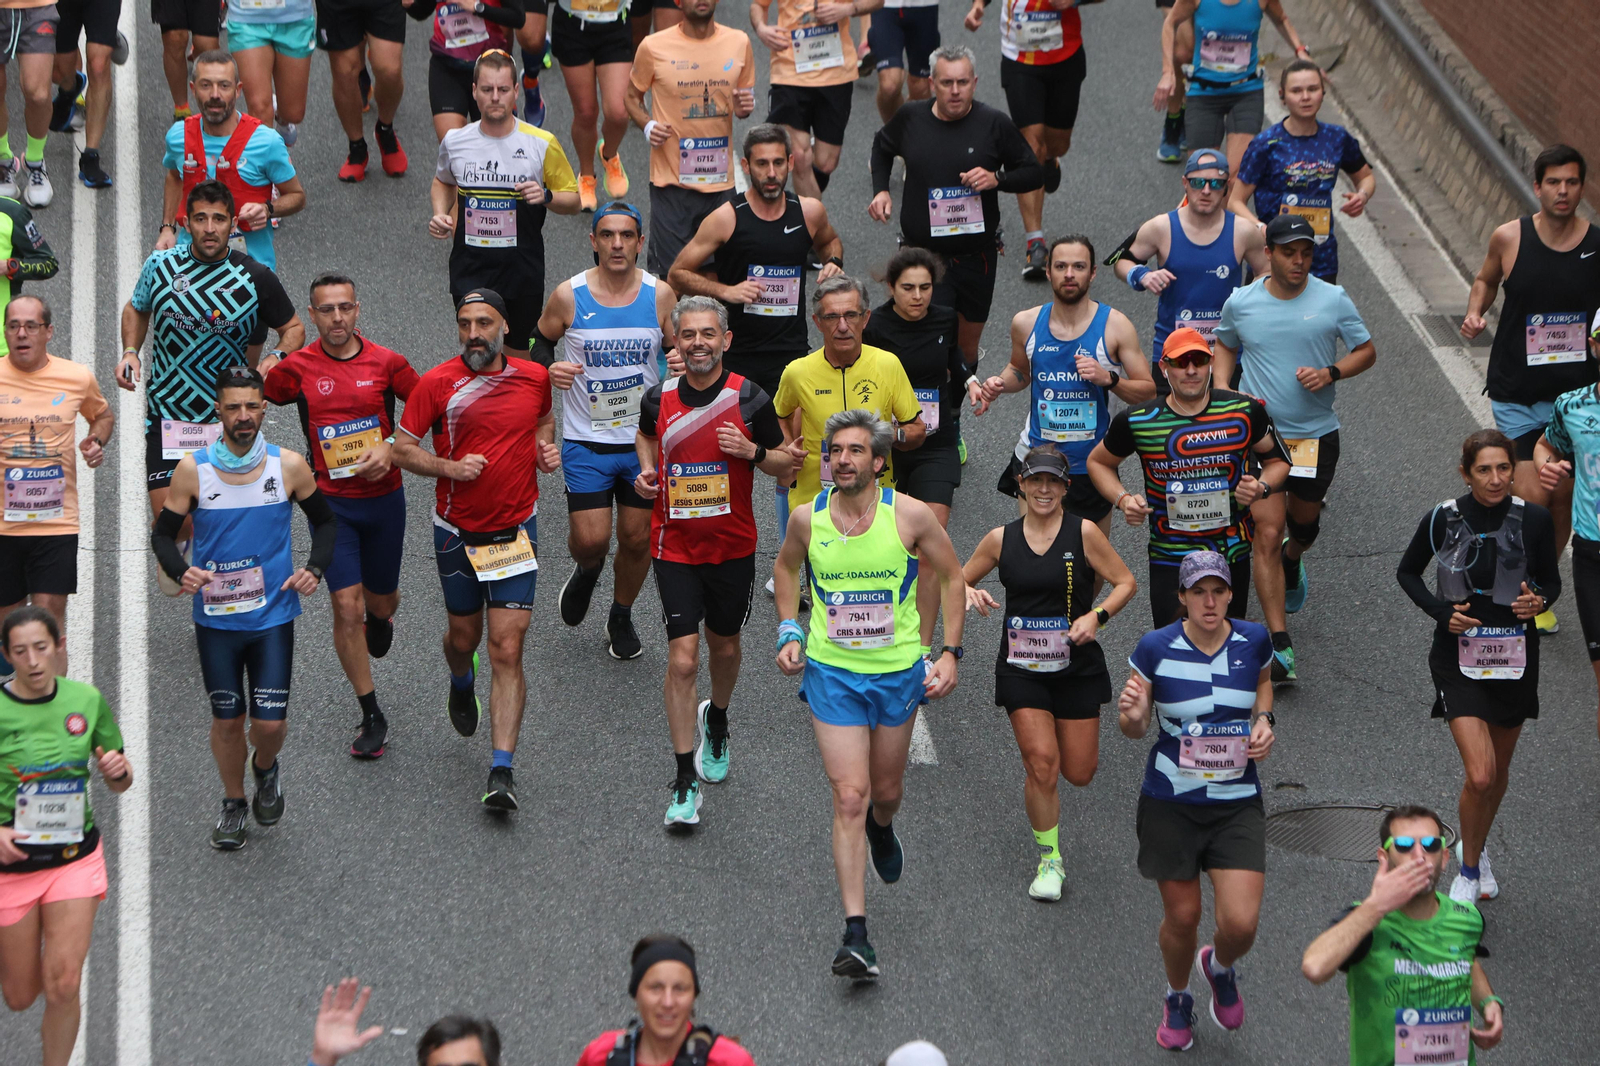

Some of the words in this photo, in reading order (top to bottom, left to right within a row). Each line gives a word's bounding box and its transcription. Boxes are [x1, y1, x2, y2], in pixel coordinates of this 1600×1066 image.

[1031, 12, 1057, 20] ZURICH
[808, 26, 834, 36] ZURICH
[697, 139, 723, 148] ZURICH
[697, 155, 714, 164] 6712
[694, 166, 717, 174] ARNAUD
[480, 200, 510, 209] ZURICH
[1300, 198, 1327, 206] ZURICH
[946, 204, 965, 213] 7088
[480, 216, 499, 225] 7153
[477, 229, 502, 237] FORILLO
[767, 268, 795, 276] ZURICH
[765, 284, 784, 293] 7333
[1195, 311, 1222, 319] ZURIC
[1546, 314, 1580, 324] ZURICH
[1546, 331, 1566, 340] 7453
[583, 338, 652, 351] RUNNING
[1547, 344, 1566, 352] TIAGO
[1038, 371, 1091, 382] GARMI
[606, 378, 637, 390] ZURICH
[914, 392, 933, 400] RICH
[1057, 391, 1090, 399] ZURICH
[608, 396, 628, 407] 9229
[613, 409, 627, 417] DITO
[1054, 408, 1079, 417] 12074
[338, 419, 373, 435] ZURICH
[1048, 422, 1068, 430] DAVID
[1068, 421, 1086, 430] MAIA
[182, 426, 203, 435] 8059
[1186, 430, 1228, 444] XXXVIII
[179, 440, 208, 448] MINIBEA
[342, 440, 364, 452] 3978
[336, 456, 361, 467] LIAM-
[1149, 459, 1170, 470] SAN
[1171, 454, 1231, 468] SILVESTRE
[27, 468, 59, 478] ZURICH
[686, 483, 708, 493] 5089
[1187, 481, 1222, 491] ZURICH
[26, 487, 47, 496] 8057
[9, 500, 32, 509] PAULO
[33, 498, 61, 508] MARTINS
[673, 497, 693, 506] JESÚS
[694, 496, 726, 506] CAMISÓN
[1187, 499, 1209, 508] 8720
[1201, 511, 1223, 519] ELENA
[488, 543, 510, 555] 6146
[219, 558, 254, 571] ZURICH
[221, 578, 243, 589] 7392
[848, 593, 885, 602] ZURICH
[849, 612, 870, 622] 7941
[1027, 620, 1061, 629] ZURICH
[836, 628, 855, 636] CRIS
[856, 628, 862, 636] &
[863, 626, 886, 635] MANU
[1481, 627, 1516, 635] ZURICH
[1028, 637, 1048, 647] 7919
[1481, 645, 1504, 653] 7817
[1035, 651, 1066, 660] MORAGA
[1476, 658, 1509, 666] REUNION
[253, 687, 289, 696] Fundación
[256, 698, 286, 709] Cajasol
[1207, 725, 1243, 735] ZURICH
[1204, 744, 1227, 754] 7804
[1195, 760, 1235, 768] RAQUELITA
[42, 782, 78, 793] ZURICH
[1424, 1010, 1464, 1024] ZURICH
[1423, 1034, 1449, 1046] 7316
